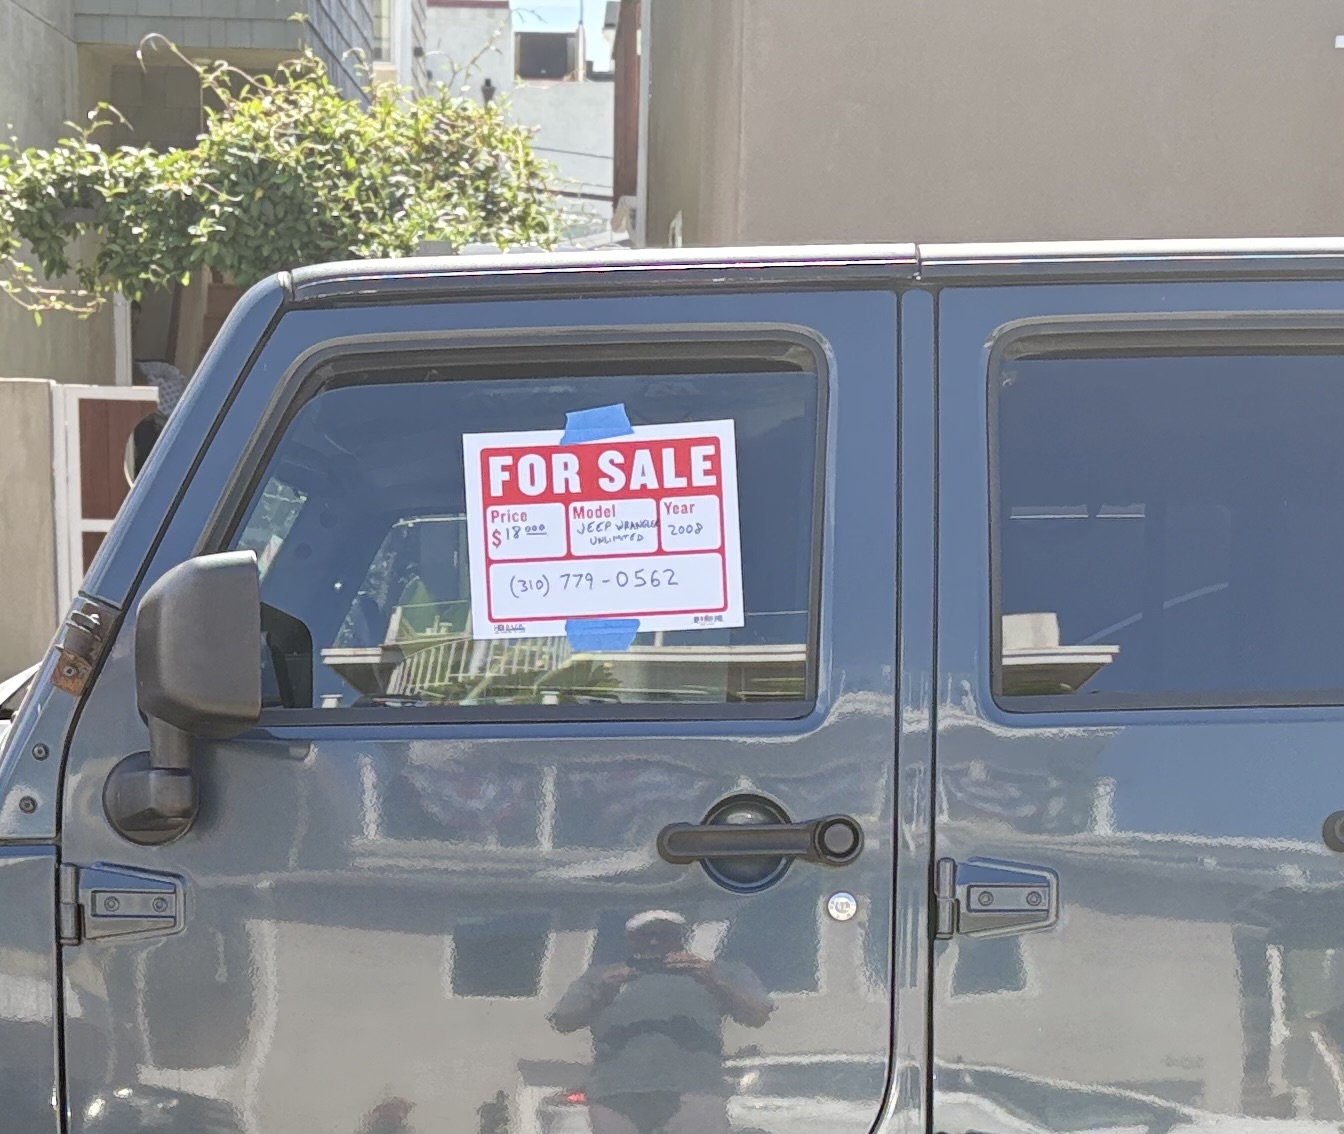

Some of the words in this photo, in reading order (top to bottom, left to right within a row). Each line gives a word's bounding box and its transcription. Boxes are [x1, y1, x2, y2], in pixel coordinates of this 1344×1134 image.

[488, 453, 582, 497] FOR
[597, 445, 717, 493] SALE
[572, 504, 616, 519] Model
[663, 501, 696, 515] Year
[491, 509, 528, 523] Price
[577, 520, 612, 535] JEEP
[667, 522, 703, 536] 2008
[509, 574, 550, 598] (310)
